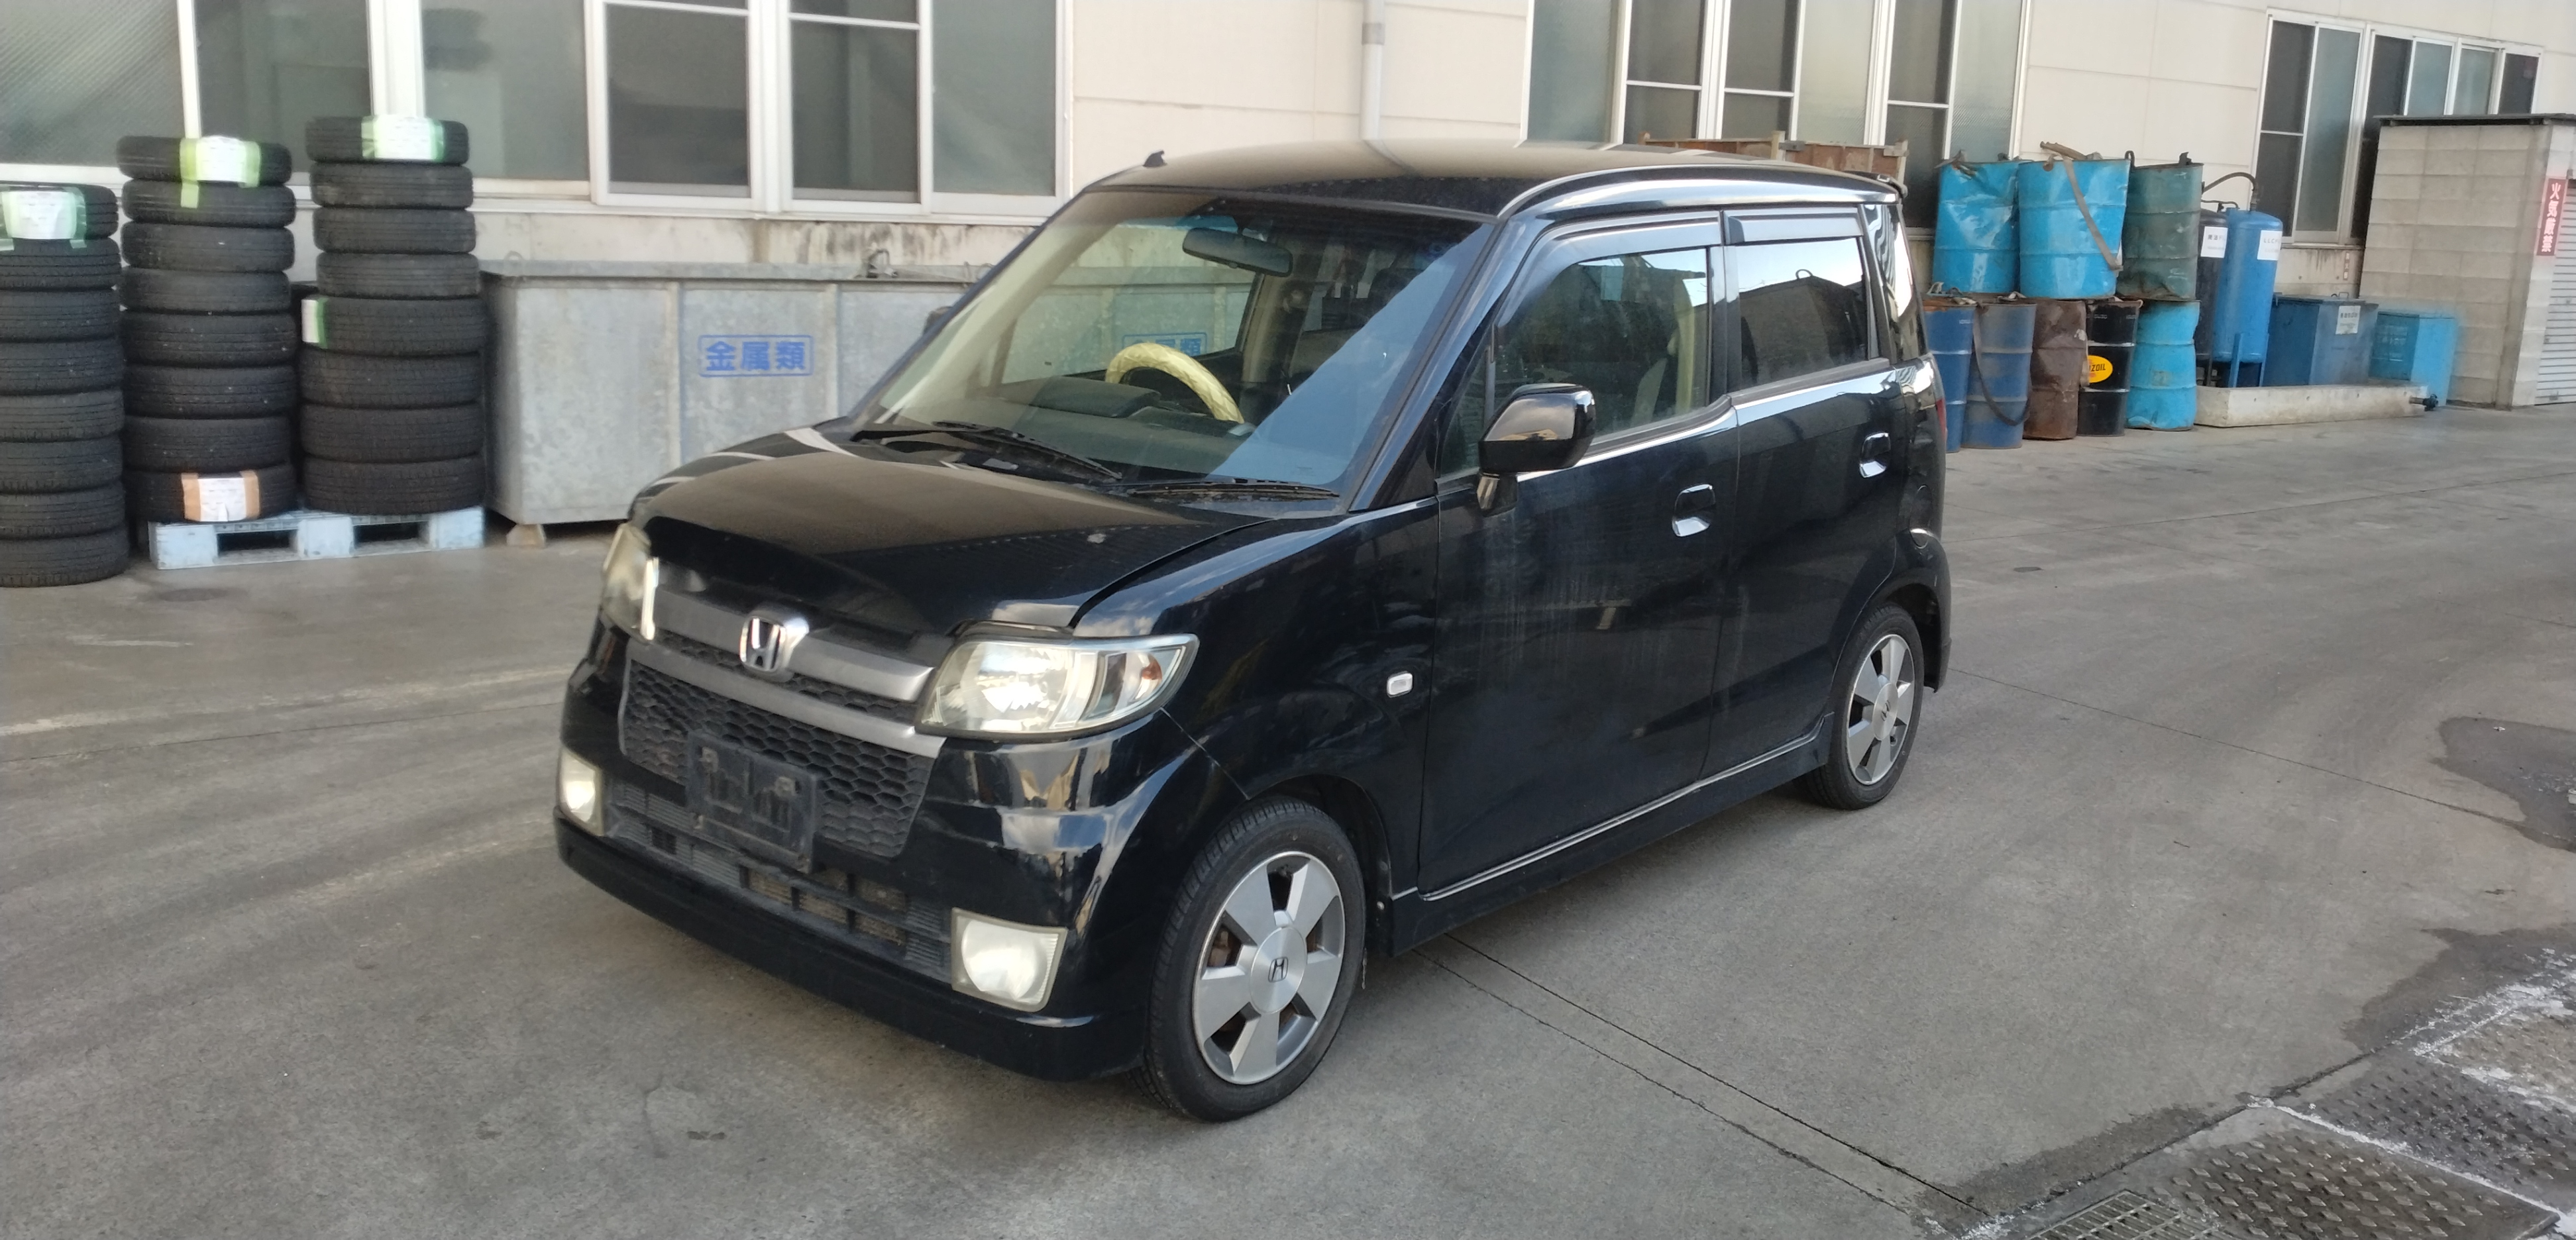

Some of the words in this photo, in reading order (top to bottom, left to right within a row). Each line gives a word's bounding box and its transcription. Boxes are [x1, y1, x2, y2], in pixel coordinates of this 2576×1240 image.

[2542, 183, 2561, 252] 火気厳禁
[706, 341, 805, 371] 金属類
[2089, 363, 2106, 372] ZOIL
